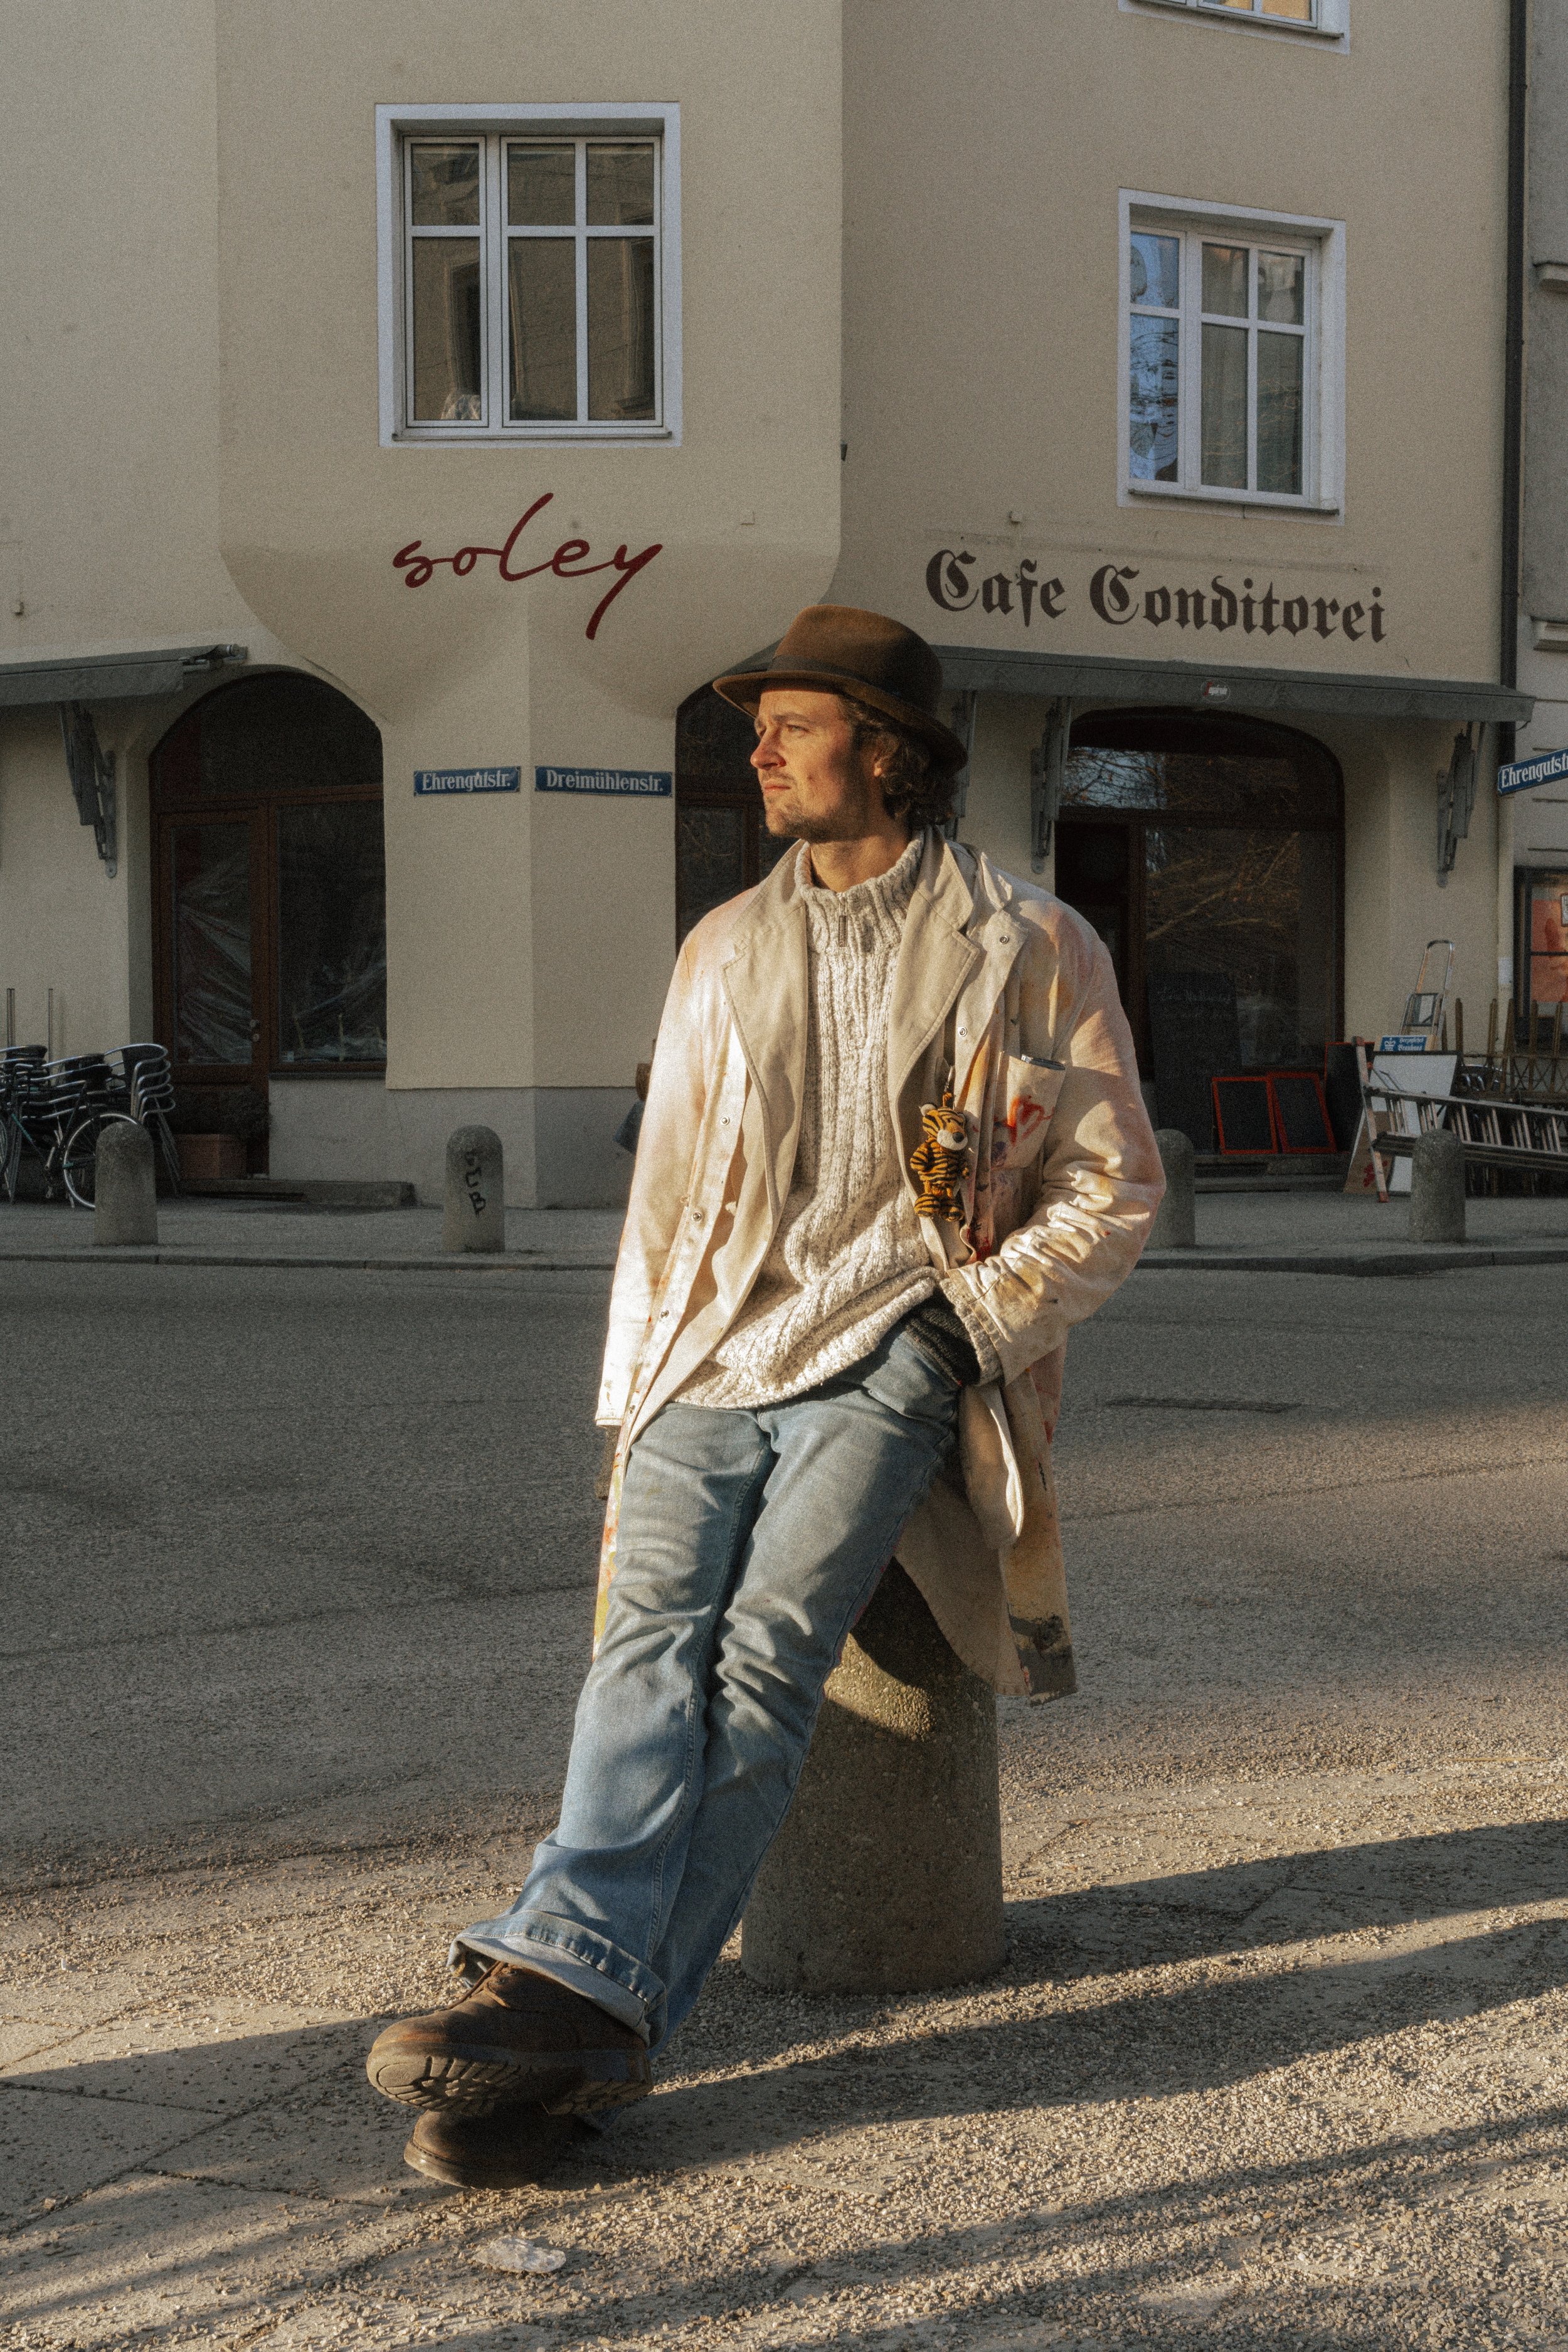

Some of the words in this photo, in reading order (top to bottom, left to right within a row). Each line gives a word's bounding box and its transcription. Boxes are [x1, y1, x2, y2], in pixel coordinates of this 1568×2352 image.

[392, 492, 664, 640] soley
[925, 549, 1066, 627] Cafe
[1089, 564, 1385, 644] Conditorei
[546, 770, 664, 793] Dreimühlenstr.
[1501, 753, 1568, 788] Ehrengutst
